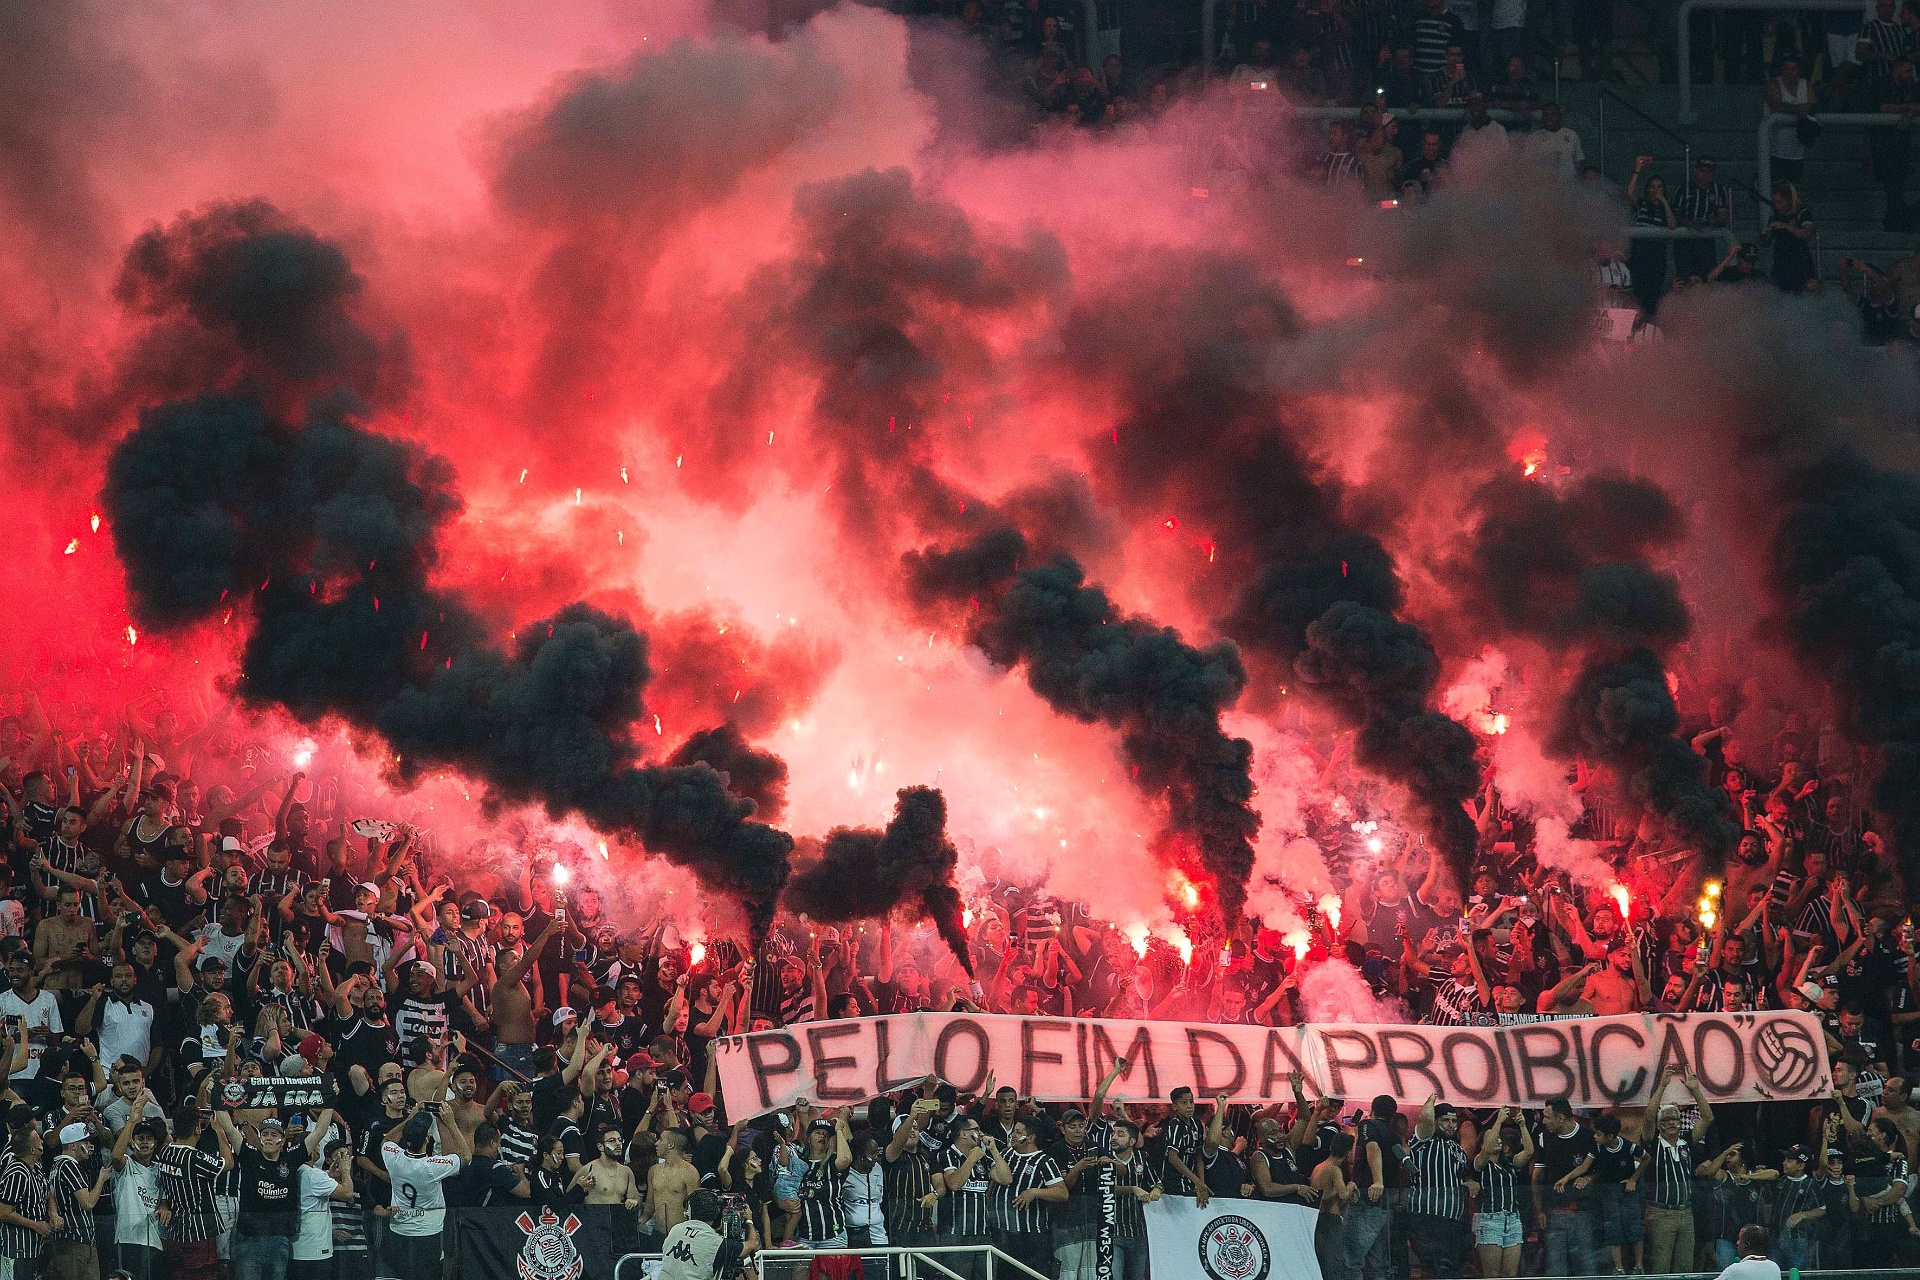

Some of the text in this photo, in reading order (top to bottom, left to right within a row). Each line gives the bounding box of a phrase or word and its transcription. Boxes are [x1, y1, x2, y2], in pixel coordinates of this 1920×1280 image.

[412, 1023, 441, 1035] CAIXA
[1020, 1020, 1160, 1099] FIM
[1186, 1027, 1324, 1099] DA
[250, 1086, 324, 1107] JÁ ERA
[158, 1162, 183, 1177] CAIXA
[402, 1182, 418, 1209] 9
[1100, 1227, 1113, 1255] SEM
